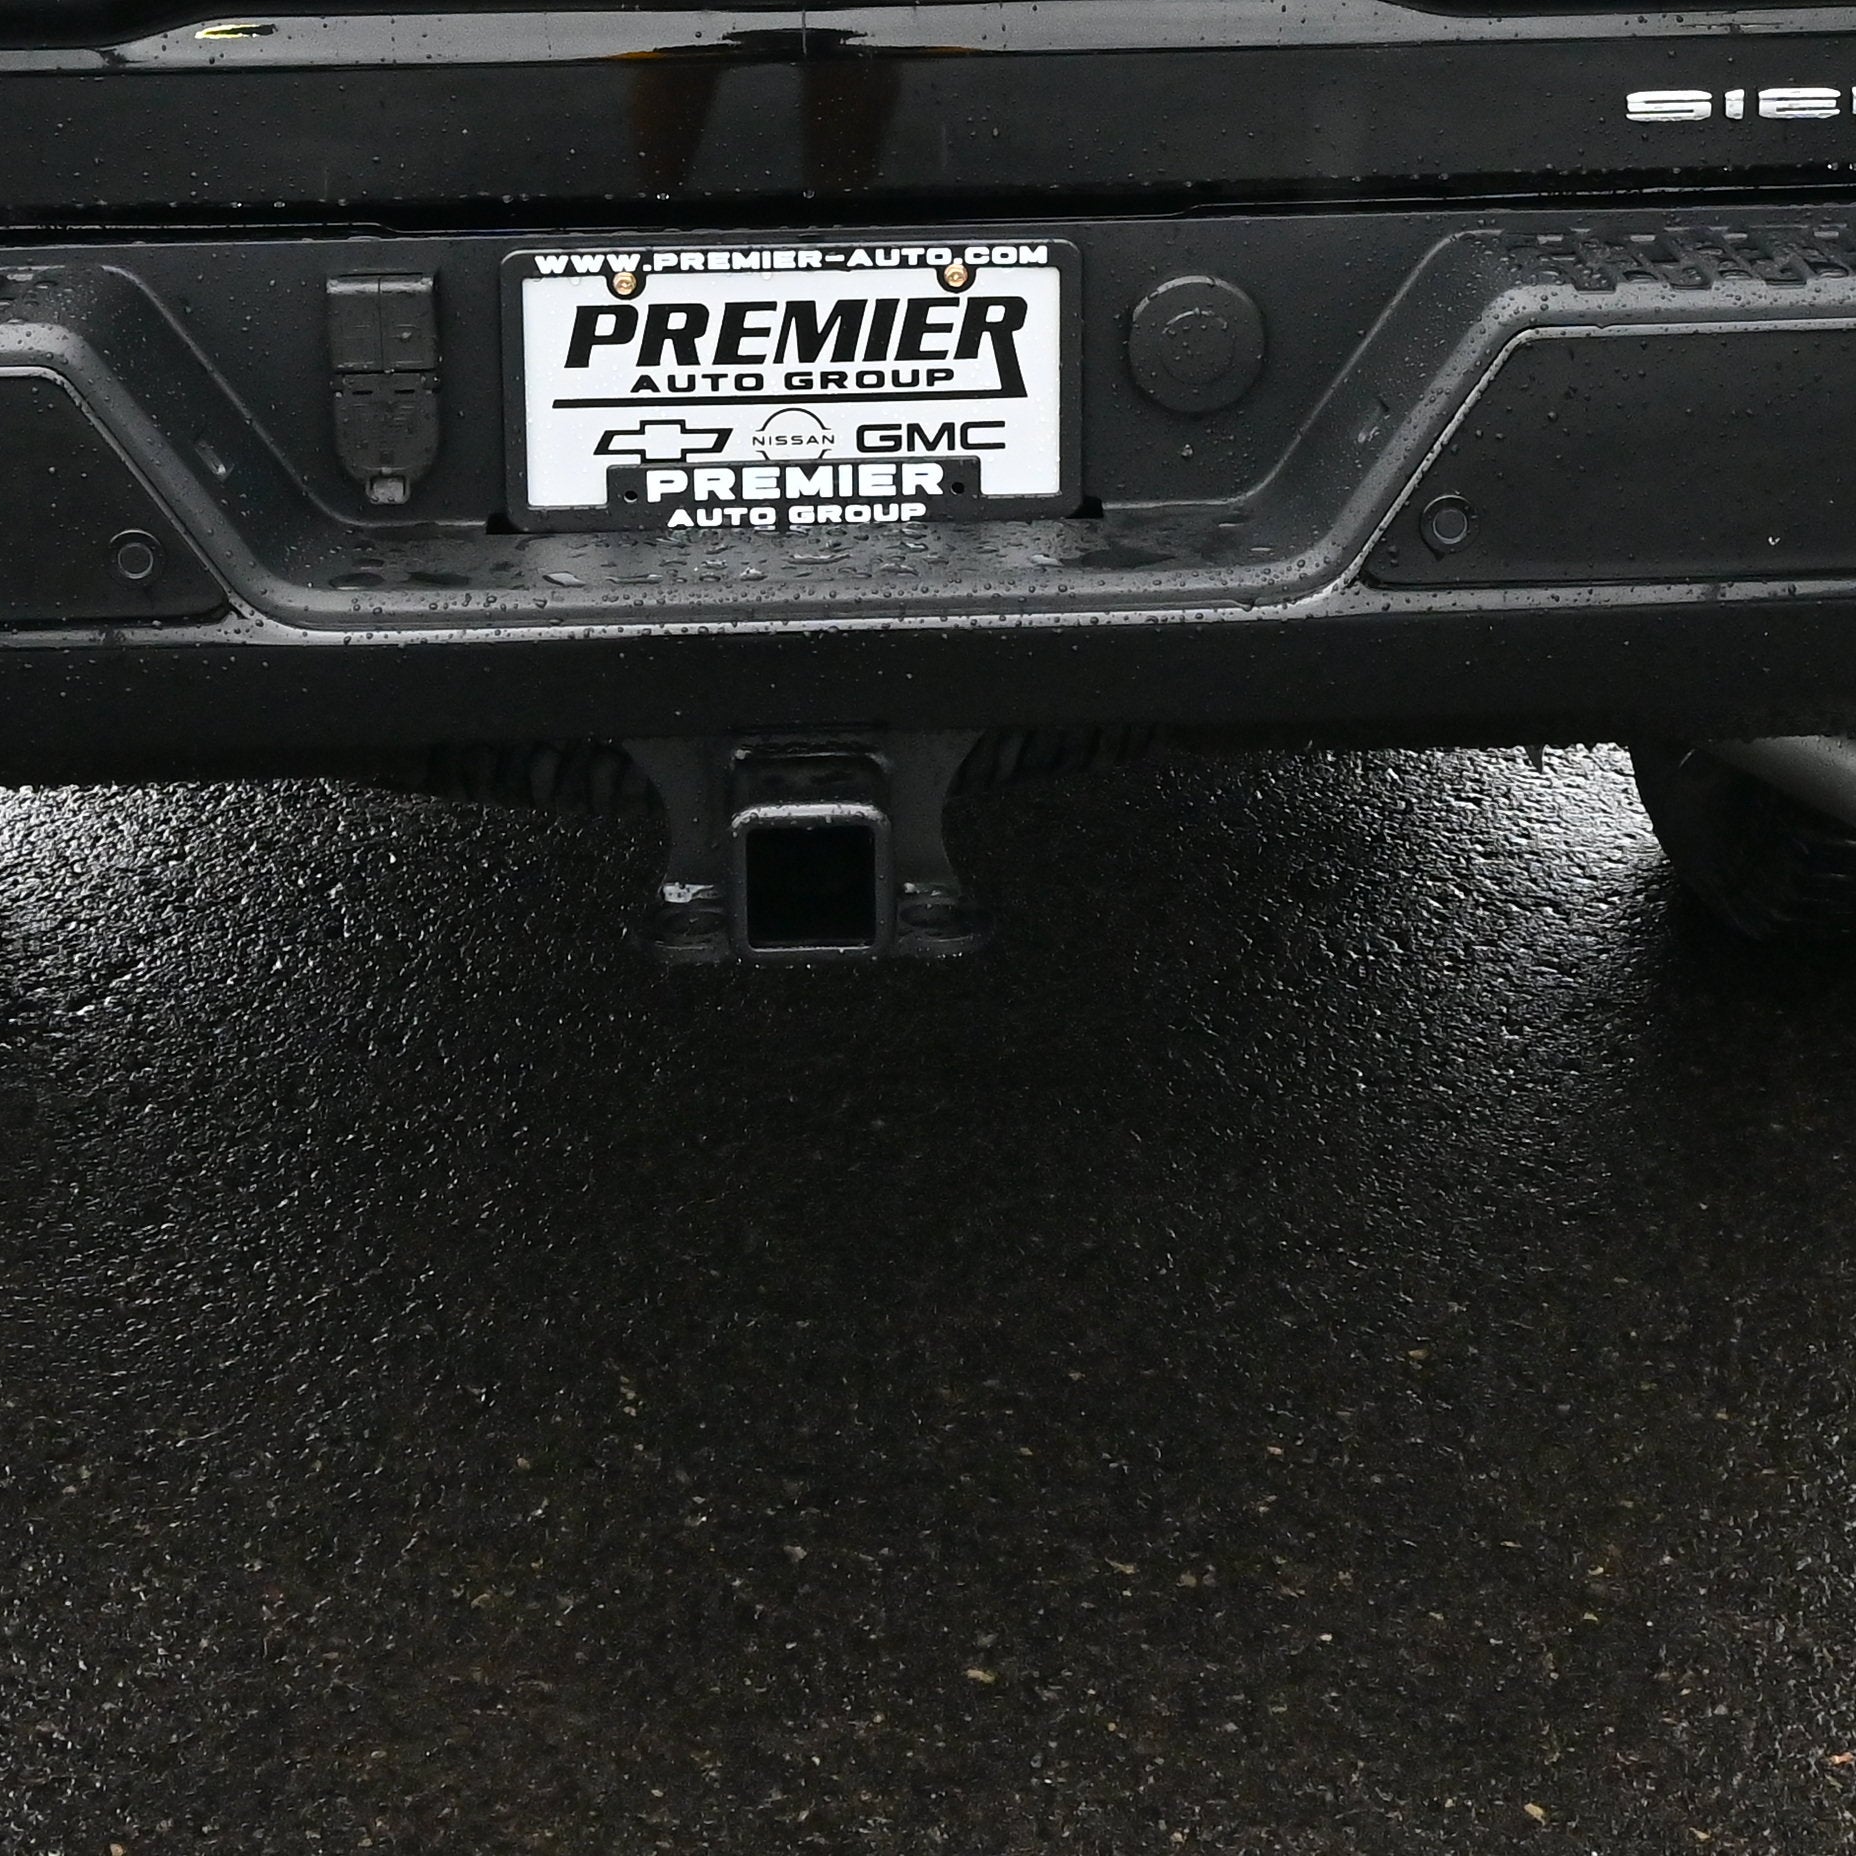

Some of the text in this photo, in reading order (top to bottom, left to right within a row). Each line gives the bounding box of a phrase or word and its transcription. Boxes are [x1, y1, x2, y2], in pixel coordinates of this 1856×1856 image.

[534, 245, 1049, 275] WWW.PREMIER-AUTO.COM
[563, 295, 1028, 398] PREMIER
[631, 367, 955, 393] AUTO GROUP
[752, 420, 1007, 454] NISSAN GMC
[646, 462, 945, 504] PREMIER
[667, 501, 927, 529] AUTO GROUP
